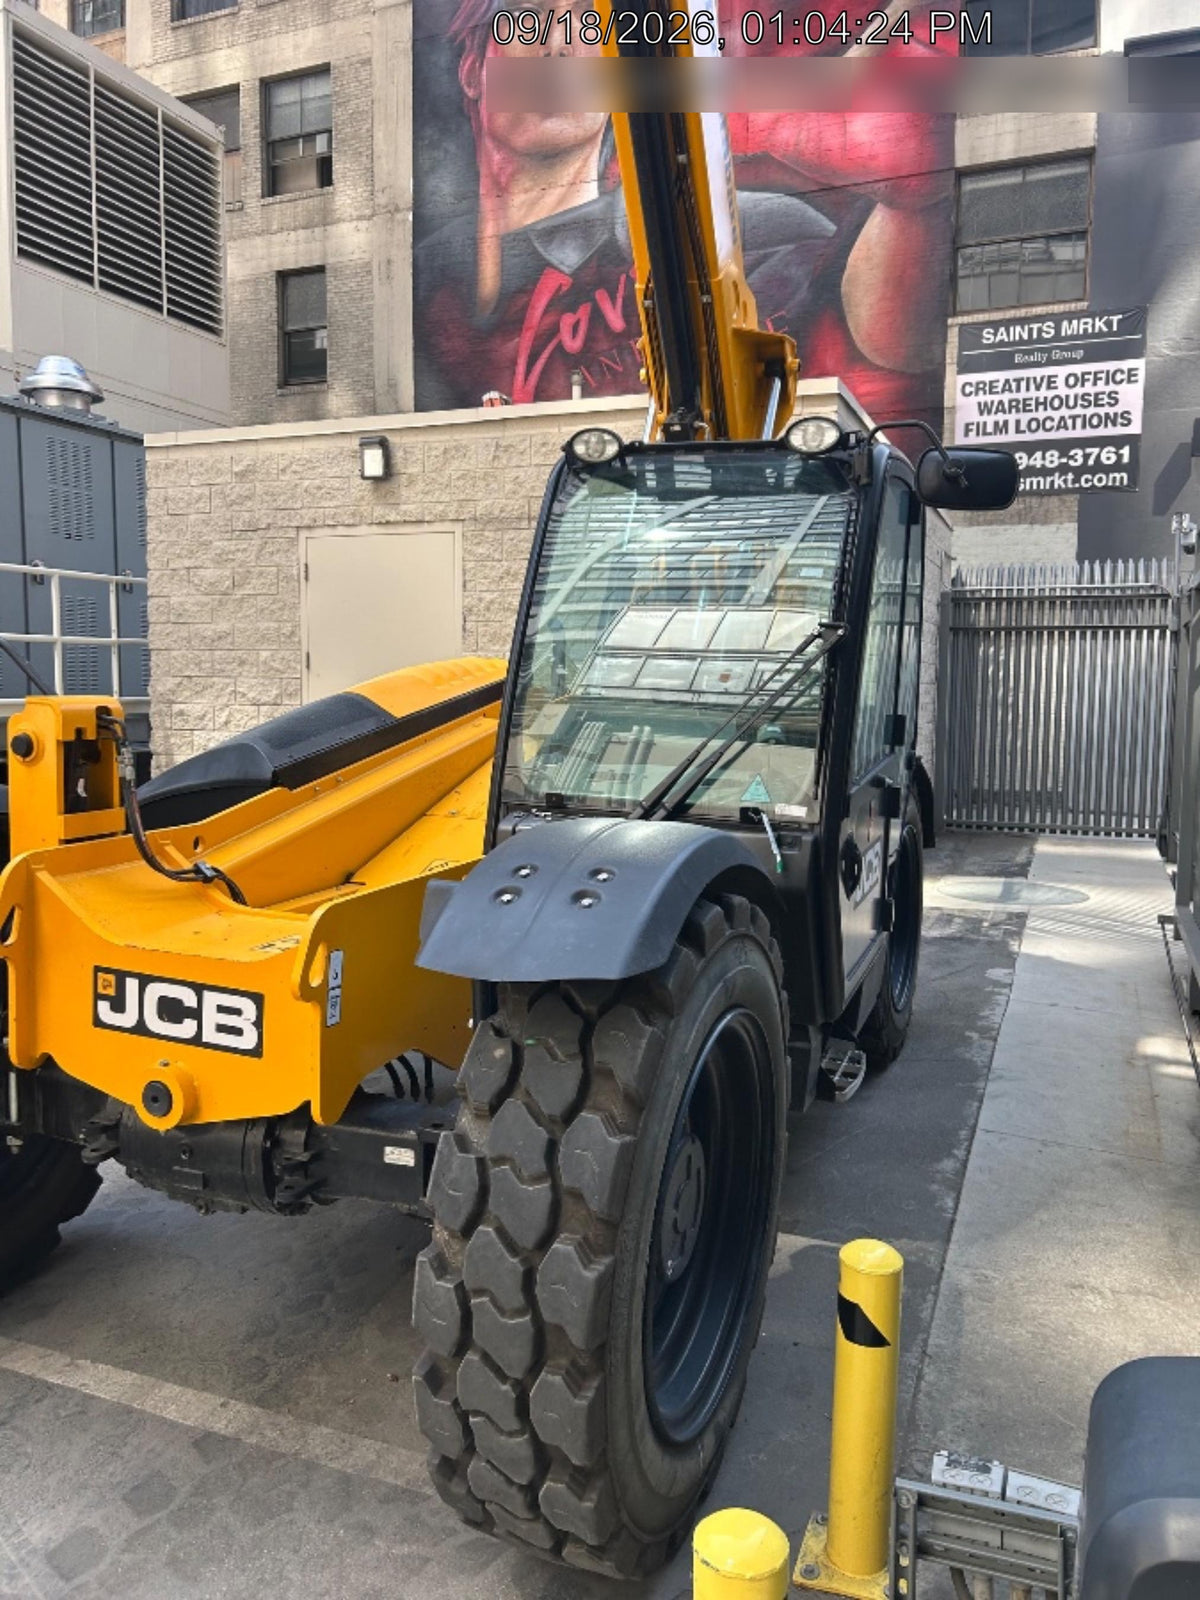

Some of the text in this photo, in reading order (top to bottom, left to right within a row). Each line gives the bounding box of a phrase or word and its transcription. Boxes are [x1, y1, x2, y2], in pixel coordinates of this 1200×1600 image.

[981, 315, 1123, 344] SAINTS MRKT
[1014, 349, 1084, 364] Realty Group
[961, 367, 1140, 397] CREATIVE OFFICE
[977, 390, 1120, 417] WAREHOUSES
[963, 410, 1132, 438] FILM LOCATIONS
[1014, 444, 1131, 470] 948-3761
[97, 977, 259, 1050] JCB
